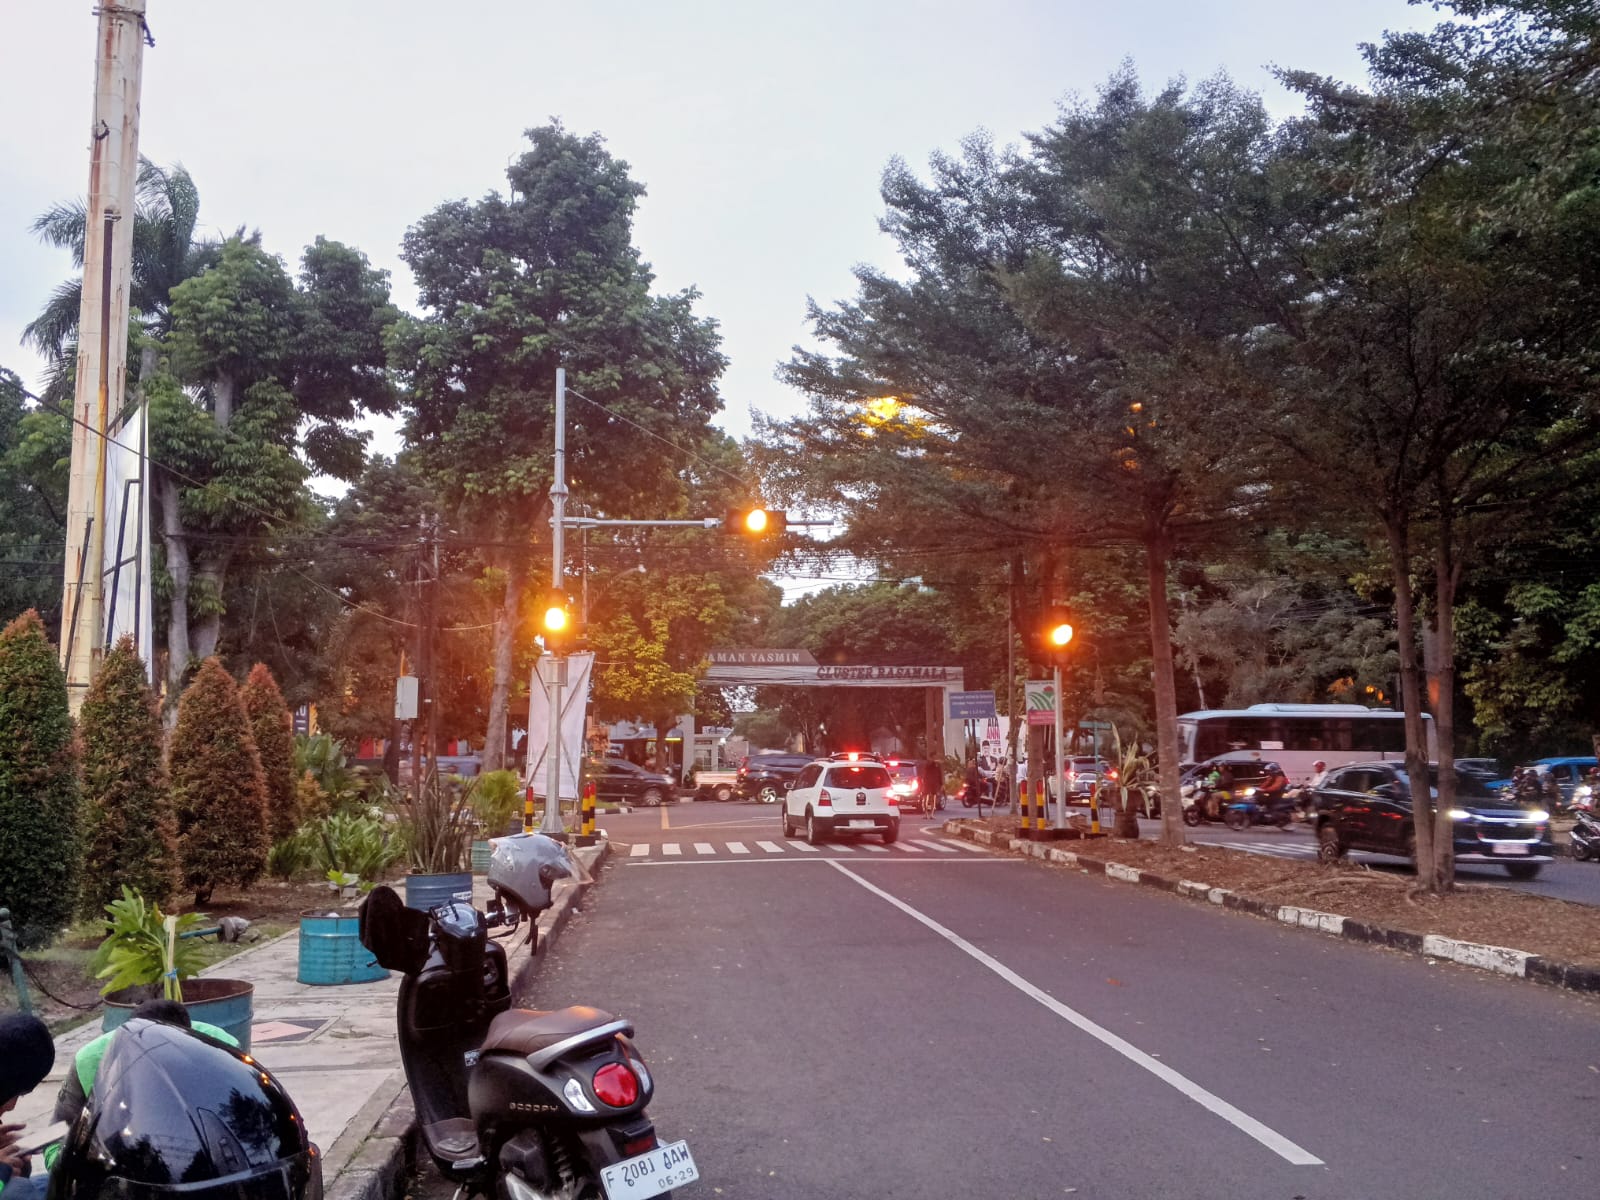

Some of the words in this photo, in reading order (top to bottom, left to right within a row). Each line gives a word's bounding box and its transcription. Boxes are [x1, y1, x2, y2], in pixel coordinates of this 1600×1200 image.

[750, 652, 800, 663] YASMIN
[816, 665, 873, 679] CLUSTER
[606, 1171, 615, 1188] F
